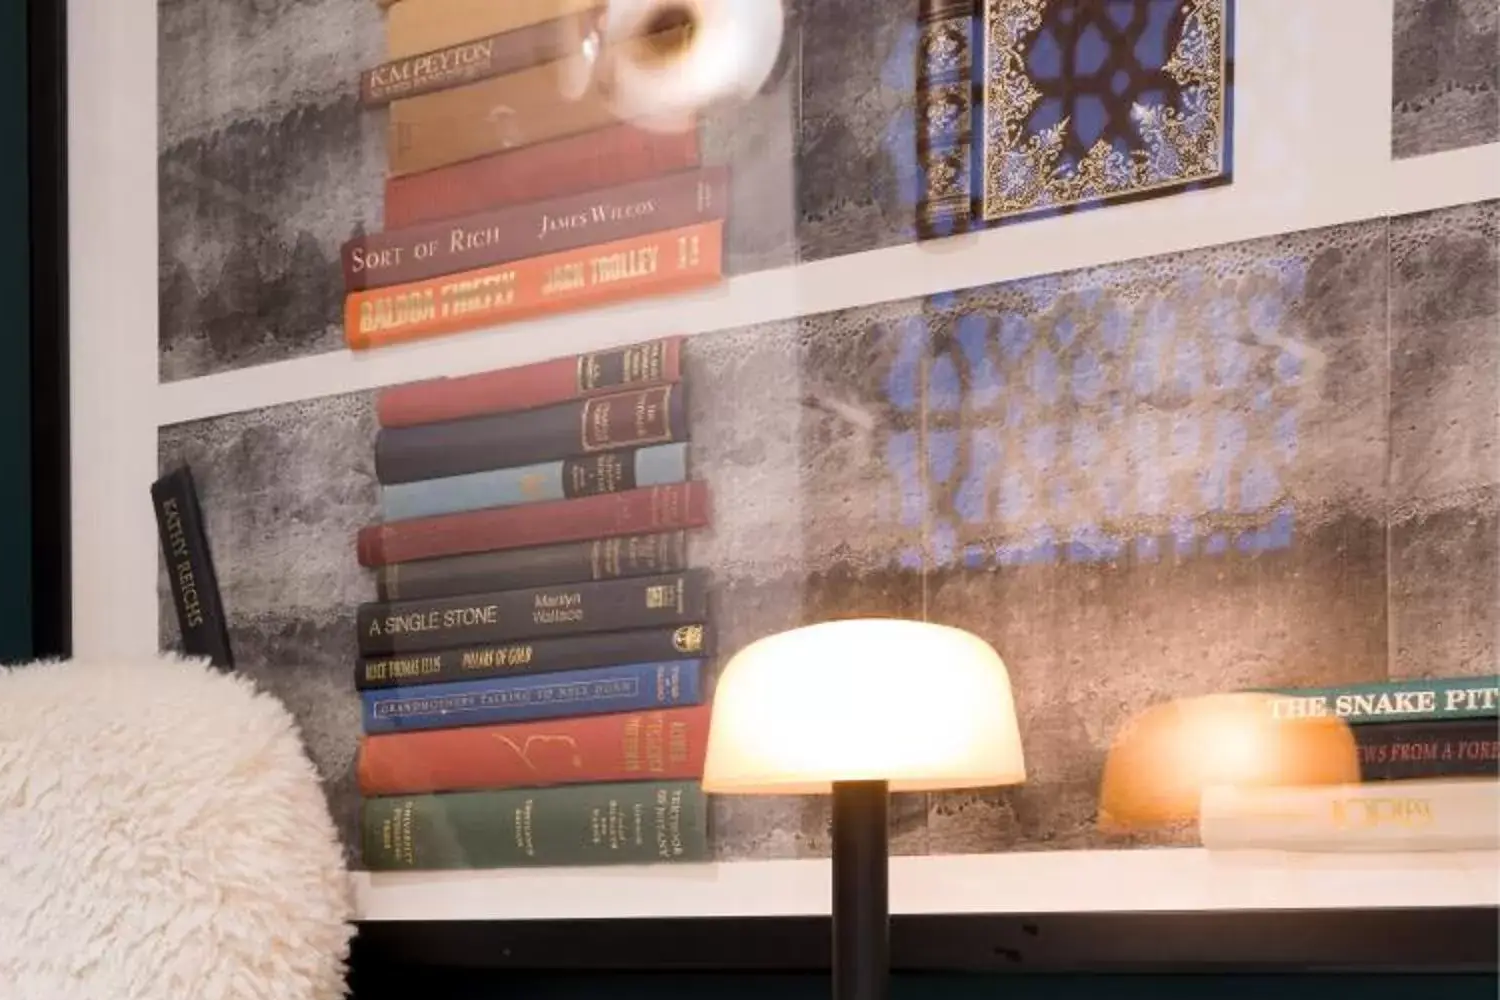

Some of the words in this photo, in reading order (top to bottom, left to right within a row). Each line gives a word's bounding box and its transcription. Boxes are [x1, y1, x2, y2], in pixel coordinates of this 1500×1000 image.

[537, 211, 588, 240] JAMES
[591, 199, 660, 222] WILCOX
[351, 247, 403, 273] SORT
[414, 241, 439, 259] OF
[450, 226, 501, 252] RICH
[590, 245, 659, 285] TROLLEY
[163, 498, 189, 556] KATHY
[177, 562, 204, 628] REICHS
[369, 620, 381, 636] A
[384, 613, 441, 634] SINGLE
[443, 605, 499, 627] STONE
[389, 658, 420, 679] THOMAS
[422, 656, 441, 676] ELLIS
[497, 649, 508, 666] OF
[1267, 697, 1328, 720] THE
[1335, 691, 1436, 717] SNAKE
[1444, 688, 1498, 711] PIT
[1388, 740, 1437, 763] FROM
[1441, 742, 1453, 760] A
